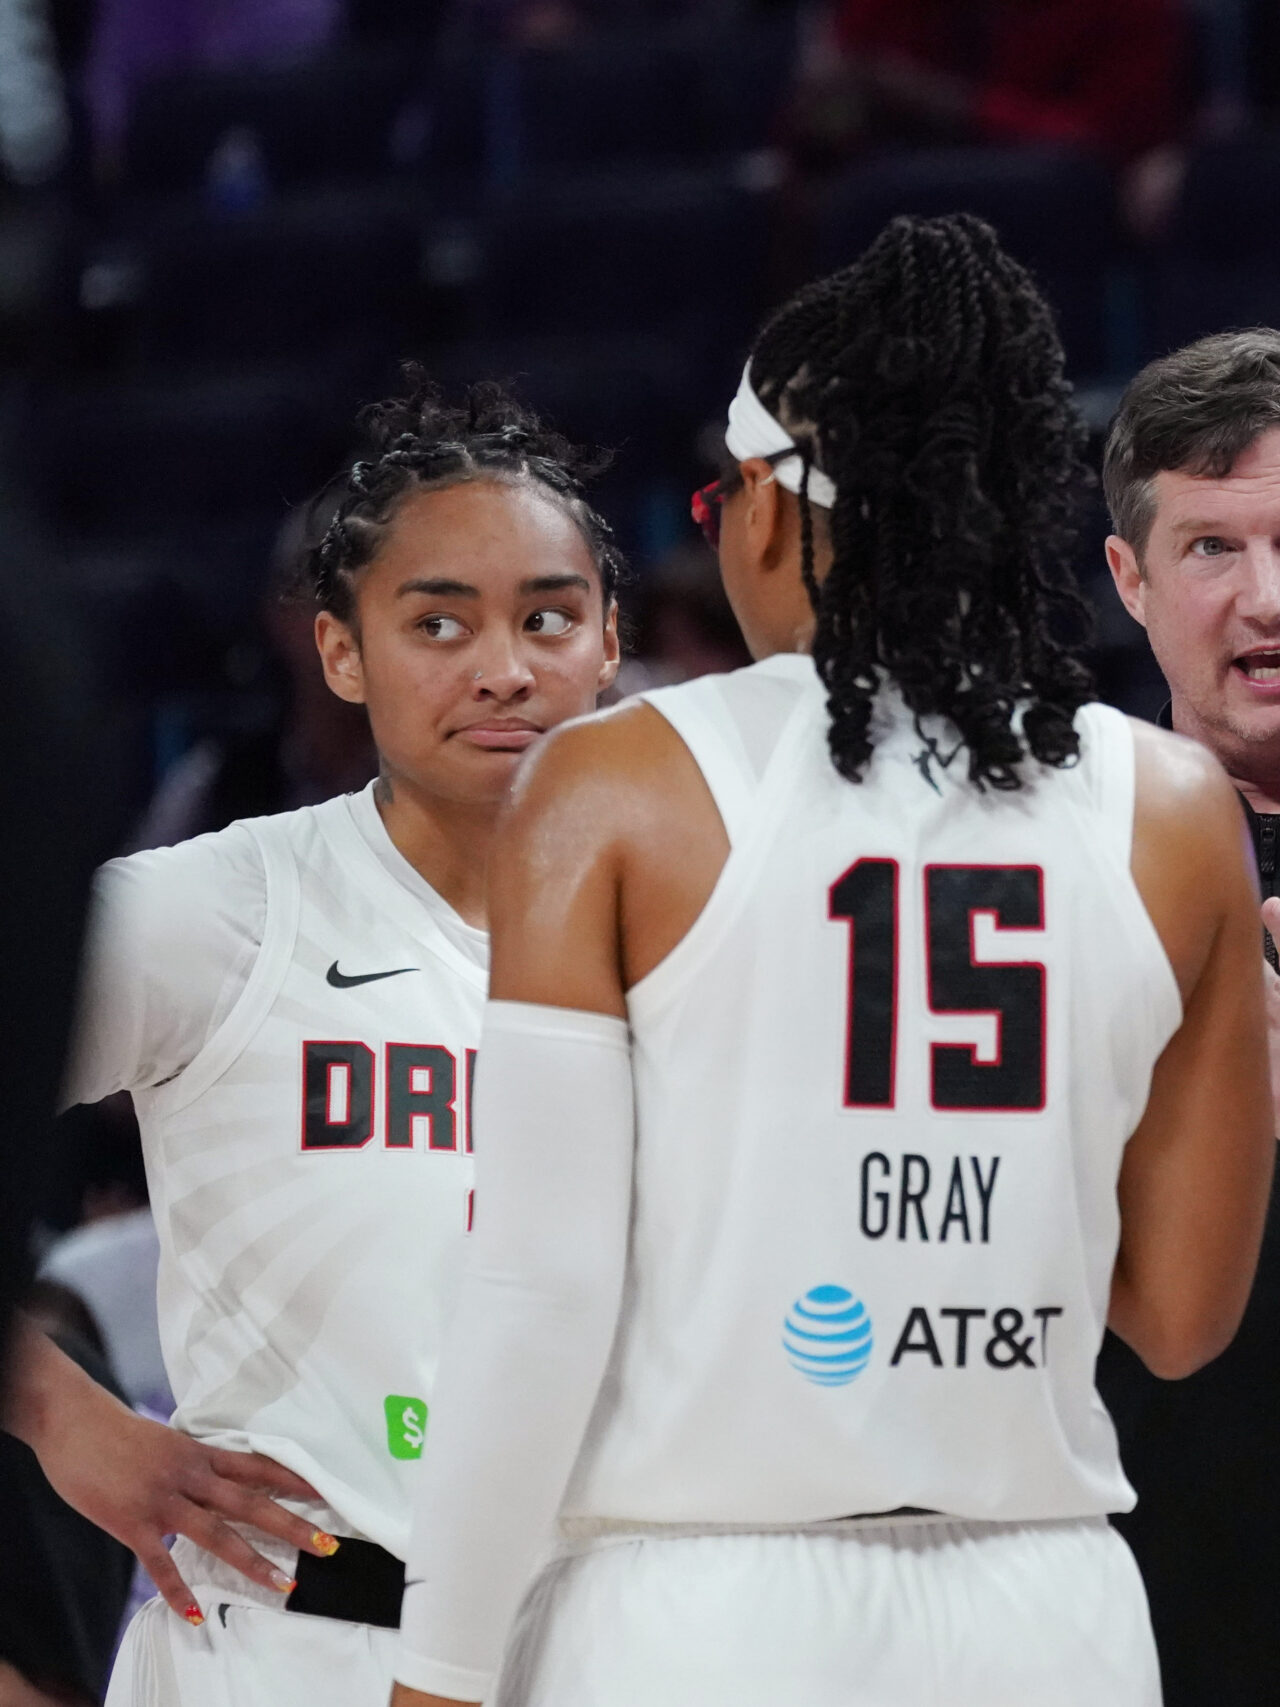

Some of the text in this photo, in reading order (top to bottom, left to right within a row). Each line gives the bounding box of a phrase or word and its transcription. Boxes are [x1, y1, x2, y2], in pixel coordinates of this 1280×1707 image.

[828, 857, 1047, 1113] 15
[859, 1151, 1001, 1243] GRAY
[889, 1307, 1063, 1370] AT&T
